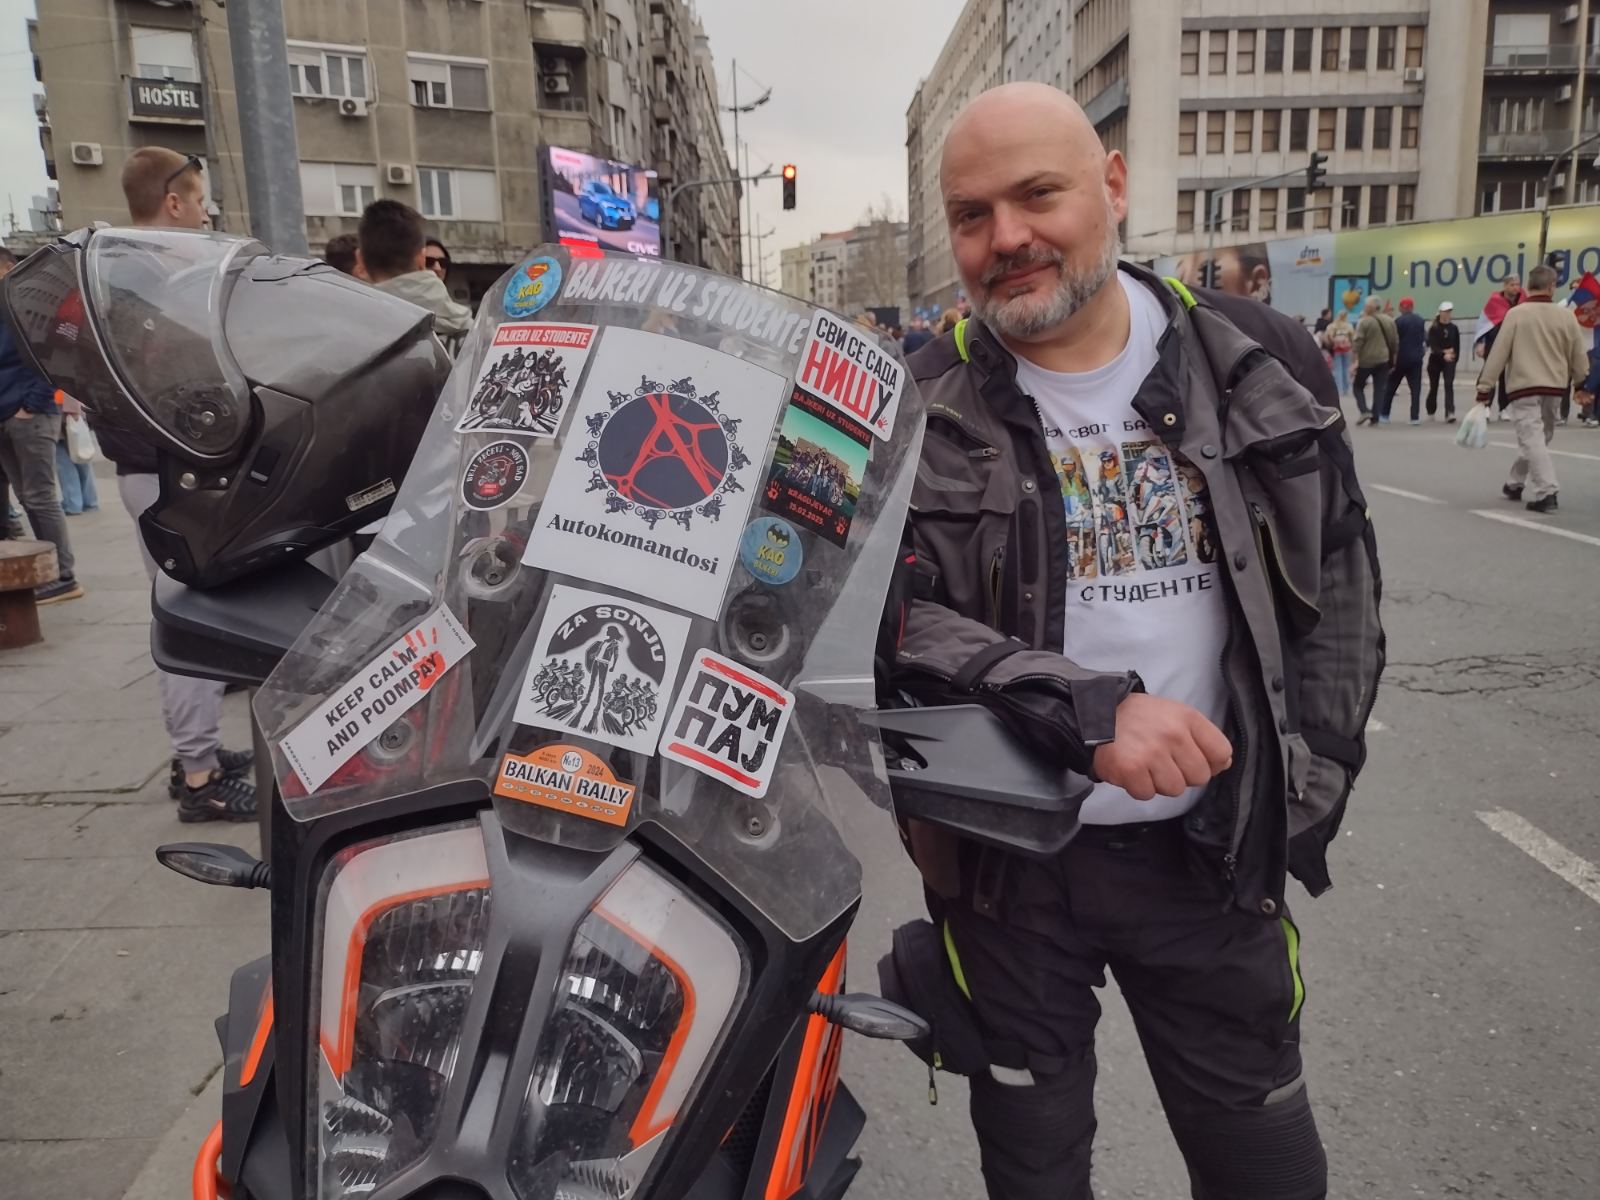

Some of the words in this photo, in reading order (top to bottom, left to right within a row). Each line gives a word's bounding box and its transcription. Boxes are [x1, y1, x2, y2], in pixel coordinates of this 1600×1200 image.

[138, 86, 200, 109] HOSTEL
[1300, 245, 1319, 258] dm
[1369, 255, 1392, 290] U
[1409, 243, 1525, 288] novoj
[563, 261, 660, 304] BAJKERI
[657, 270, 697, 312] UZ
[693, 280, 811, 355] STUDENTE
[496, 329, 529, 343] BAJKERI
[530, 330, 542, 342] UZ
[542, 330, 590, 345] STUDENTE
[815, 317, 849, 351] СВИ
[847, 336, 867, 364] СЕ
[866, 349, 898, 390] САДА
[801, 339, 893, 426] НИШУ
[793, 391, 825, 415] BAJKERI
[825, 410, 837, 420] UZ
[837, 416, 871, 442] STUDENTE
[788, 488, 832, 517] KRAGUJEVAC
[546, 513, 719, 575] Autokomandosi
[758, 545, 784, 566] KAO
[1080, 572, 1212, 603] СТУДЕНТЕ
[557, 614, 587, 640] ZA
[595, 606, 664, 662] SONJU
[325, 686, 365, 727] KEEP
[369, 646, 418, 690] CALM
[326, 719, 360, 757] AND
[361, 653, 438, 724] POOMPAY
[688, 671, 782, 743] ПУМ
[504, 760, 573, 791] BALKAN
[576, 778, 631, 805] RALLY
[586, 764, 605, 777] 2024
